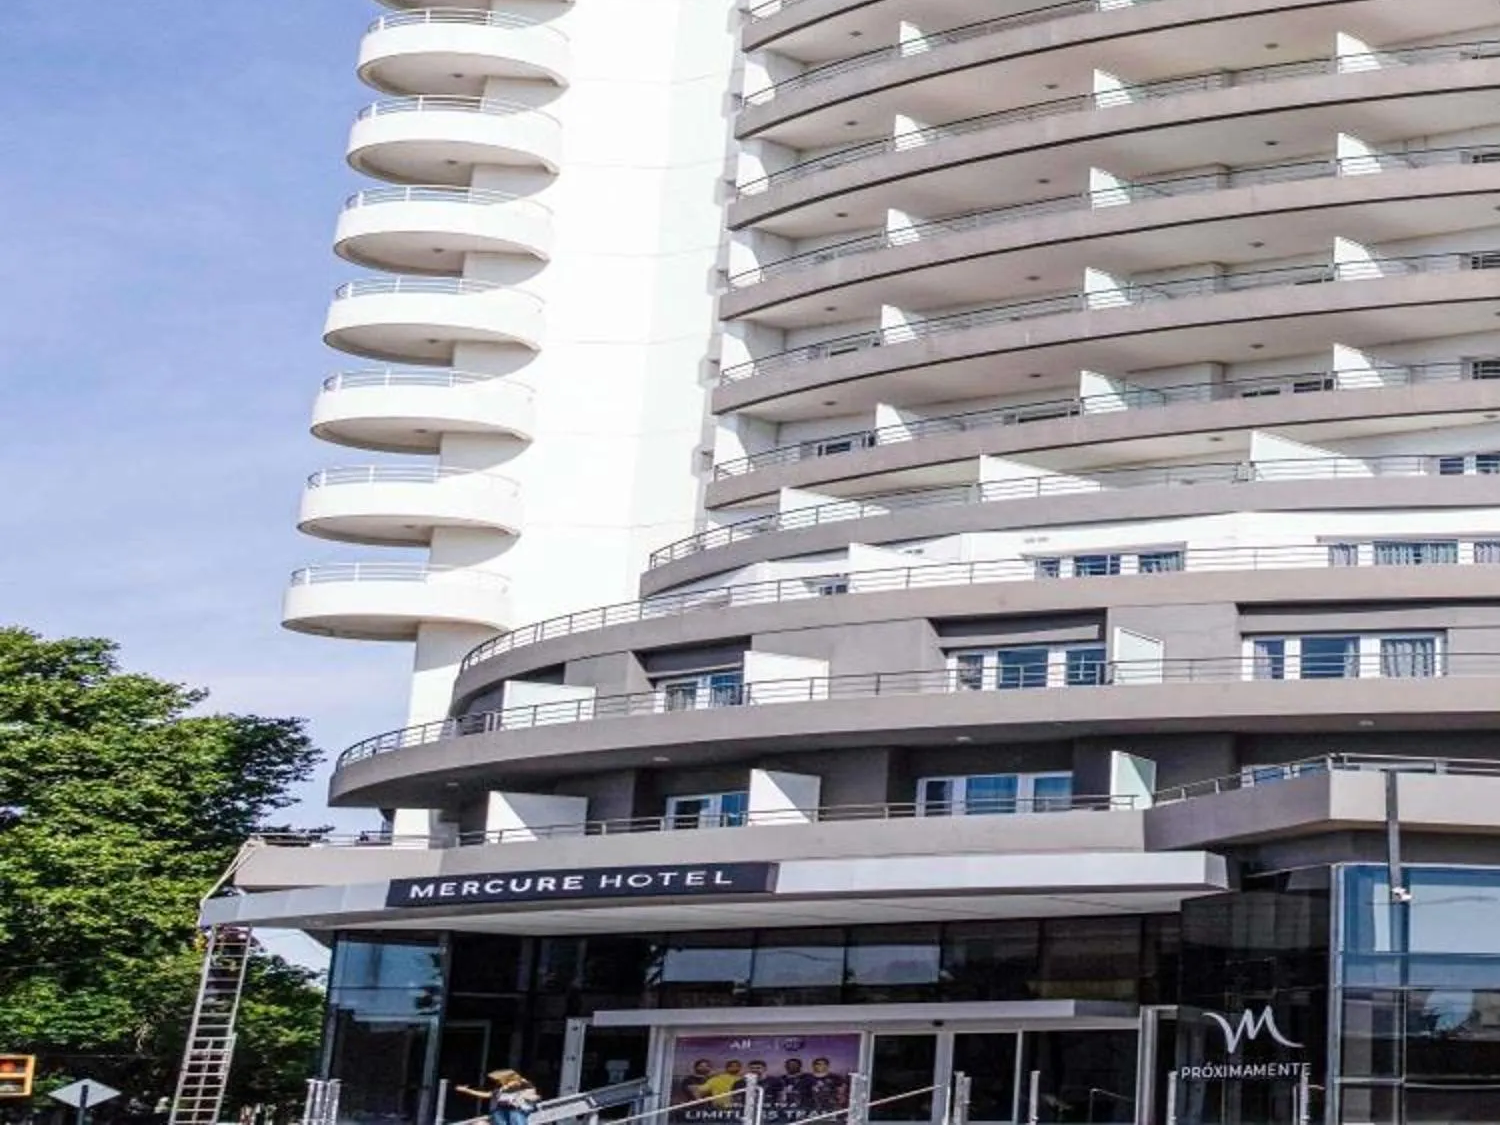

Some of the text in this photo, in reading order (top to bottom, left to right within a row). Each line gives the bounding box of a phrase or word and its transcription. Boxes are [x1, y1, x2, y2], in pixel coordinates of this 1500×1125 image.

[409, 870, 733, 899] MERCURE HOTEL
[1181, 1062, 1312, 1079] PRÓXIMAMENTE
